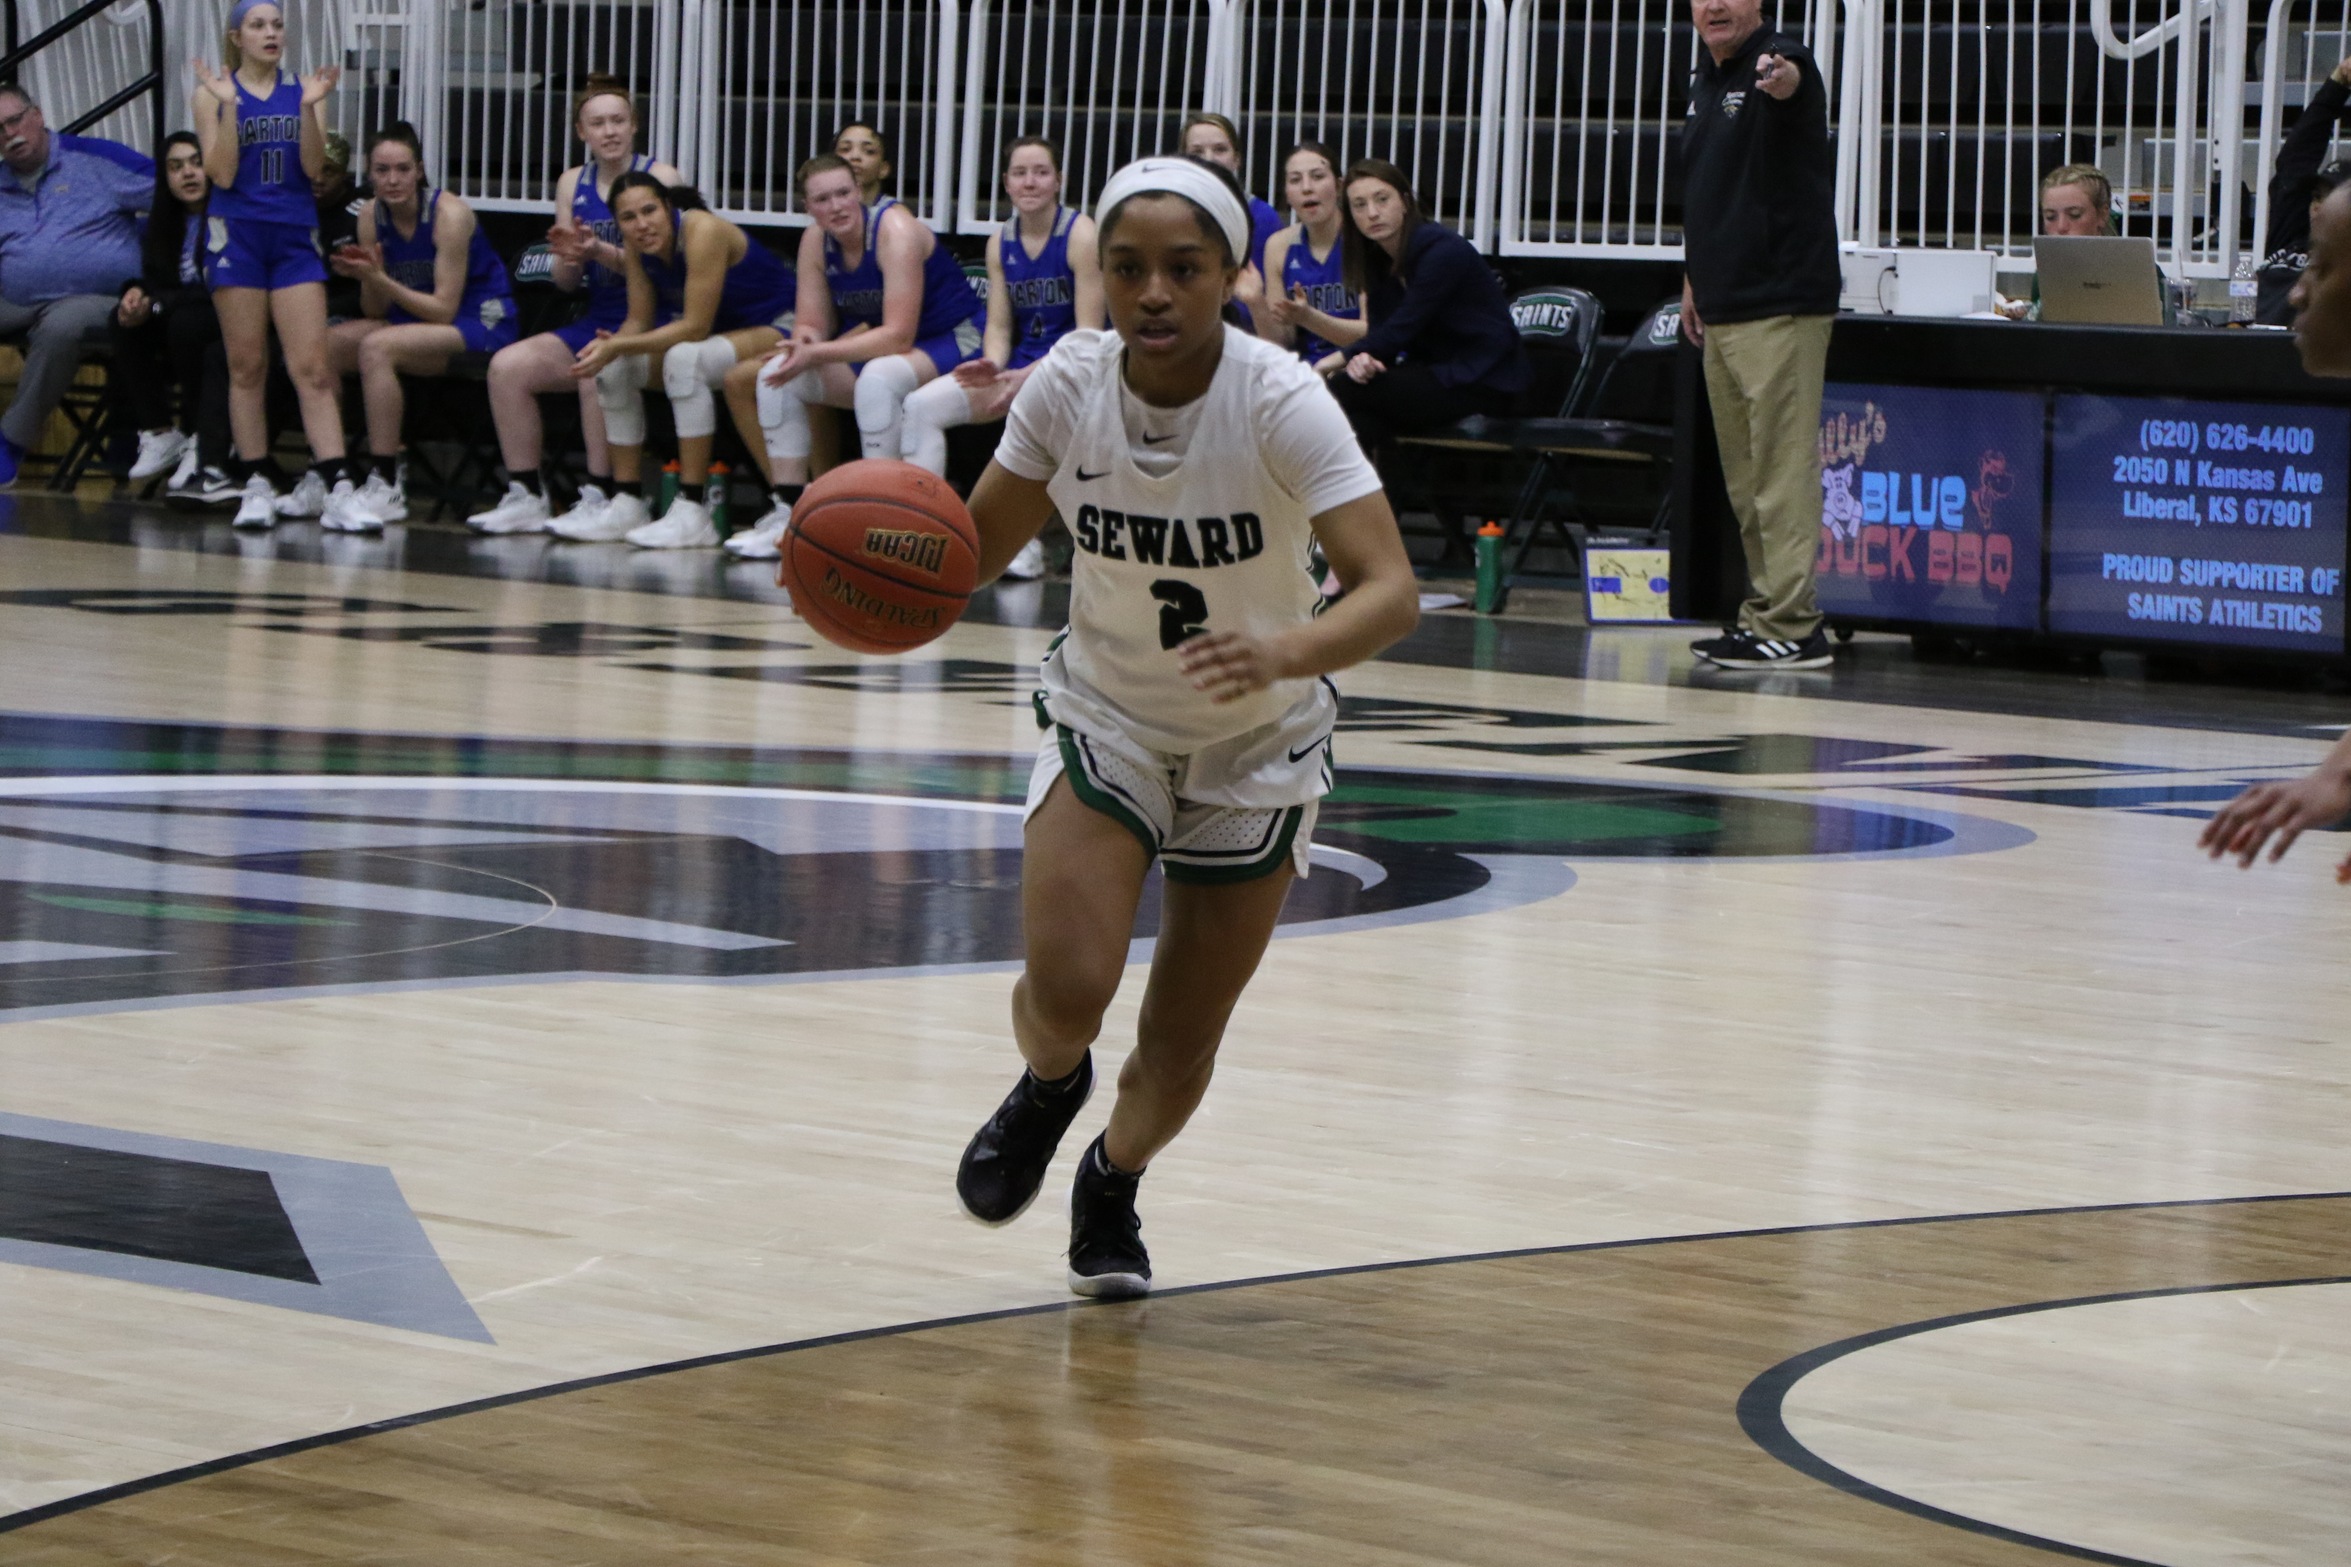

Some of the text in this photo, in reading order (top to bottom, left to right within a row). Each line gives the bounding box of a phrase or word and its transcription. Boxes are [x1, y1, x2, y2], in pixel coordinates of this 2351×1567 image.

[239, 114, 301, 145] ARTO
[261, 148, 282, 184] 11
[519, 253, 554, 274] SAIN
[1511, 303, 1572, 329] SAINTS
[2140, 418, 2315, 455] (620) 626-4400
[2113, 455, 2324, 494] 2050 N Kansas Ave
[2123, 490, 2313, 528] Liberal, KS 67901
[865, 529, 951, 577] NJCAA
[1075, 503, 1264, 569] SEWARD
[1927, 530, 2013, 594] BBQ
[2102, 552, 2341, 595] PROUD SUPPORTER OF
[820, 565, 946, 628] SPALDING
[1148, 578, 1211, 651] 2
[2127, 592, 2323, 633] SAINTS ATHLETICS
